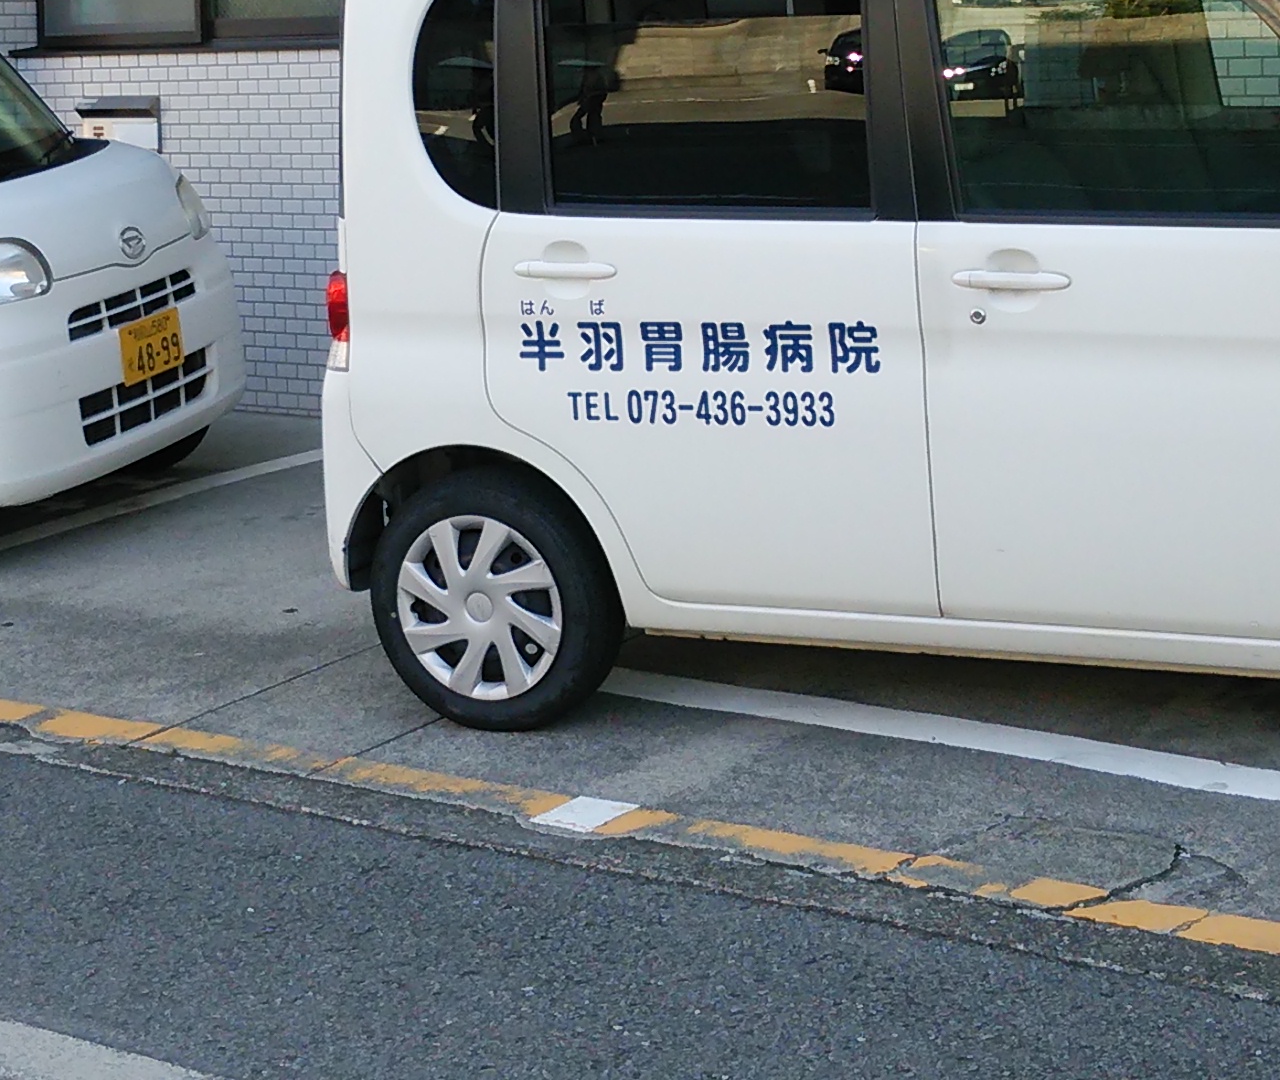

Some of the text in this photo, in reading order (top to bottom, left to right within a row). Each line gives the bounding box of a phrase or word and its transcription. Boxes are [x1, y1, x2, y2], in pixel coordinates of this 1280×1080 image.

[520, 299, 605, 316] はん ば
[519, 320, 881, 374] 半羽胃腸病院
[567, 389, 835, 428] TEL 073-436-3933
